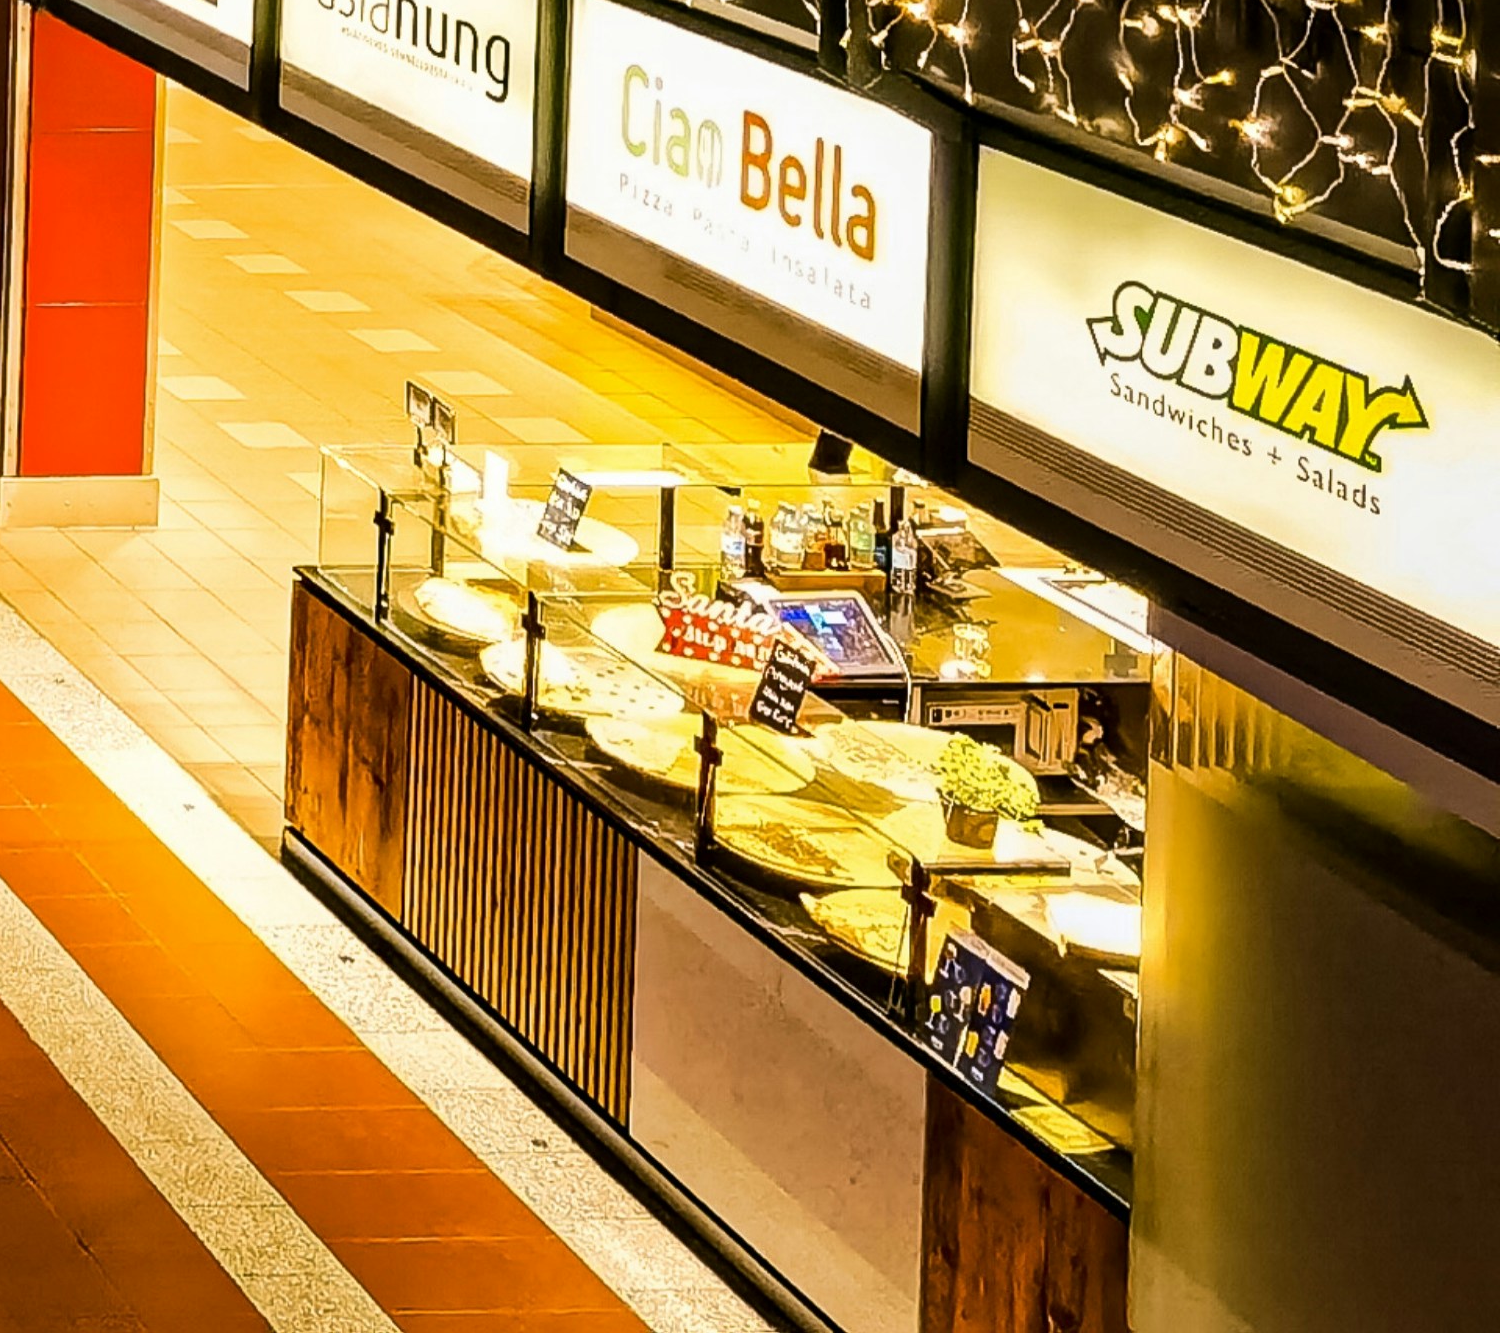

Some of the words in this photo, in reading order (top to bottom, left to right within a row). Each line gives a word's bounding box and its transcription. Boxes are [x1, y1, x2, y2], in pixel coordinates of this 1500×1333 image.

[618, 172, 674, 218] Pizza
[740, 109, 877, 262] Bella
[1086, 280, 1429, 475] SUBWAY
[1110, 372, 1253, 457] Sandwiches
[1296, 455, 1381, 516] Salads
[657, 569, 782, 637] Santa
